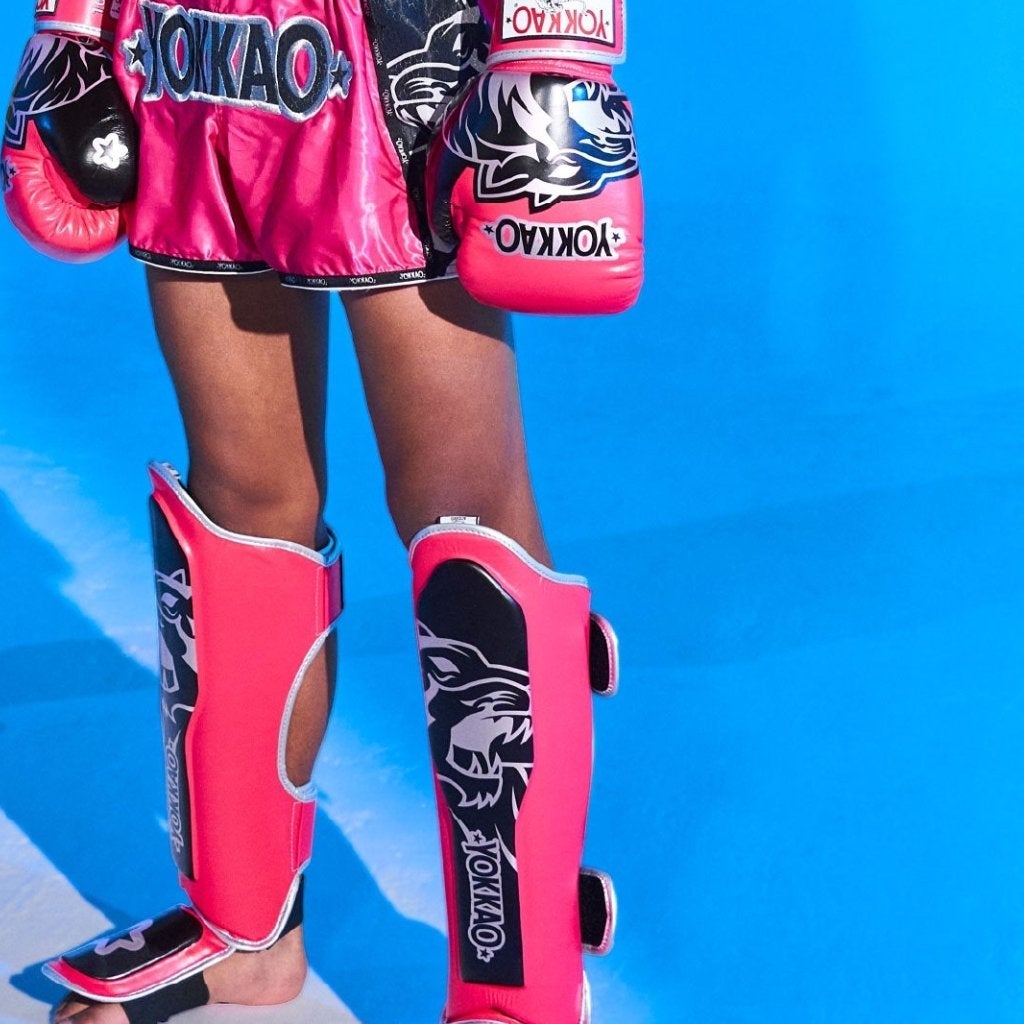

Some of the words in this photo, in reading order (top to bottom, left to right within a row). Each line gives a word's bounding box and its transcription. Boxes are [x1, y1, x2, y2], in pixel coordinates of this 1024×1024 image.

[512, 6, 607, 39] YOKKAO
[494, 217, 614, 259] YOKKAO
[462, 838, 506, 951] YOKKAO
